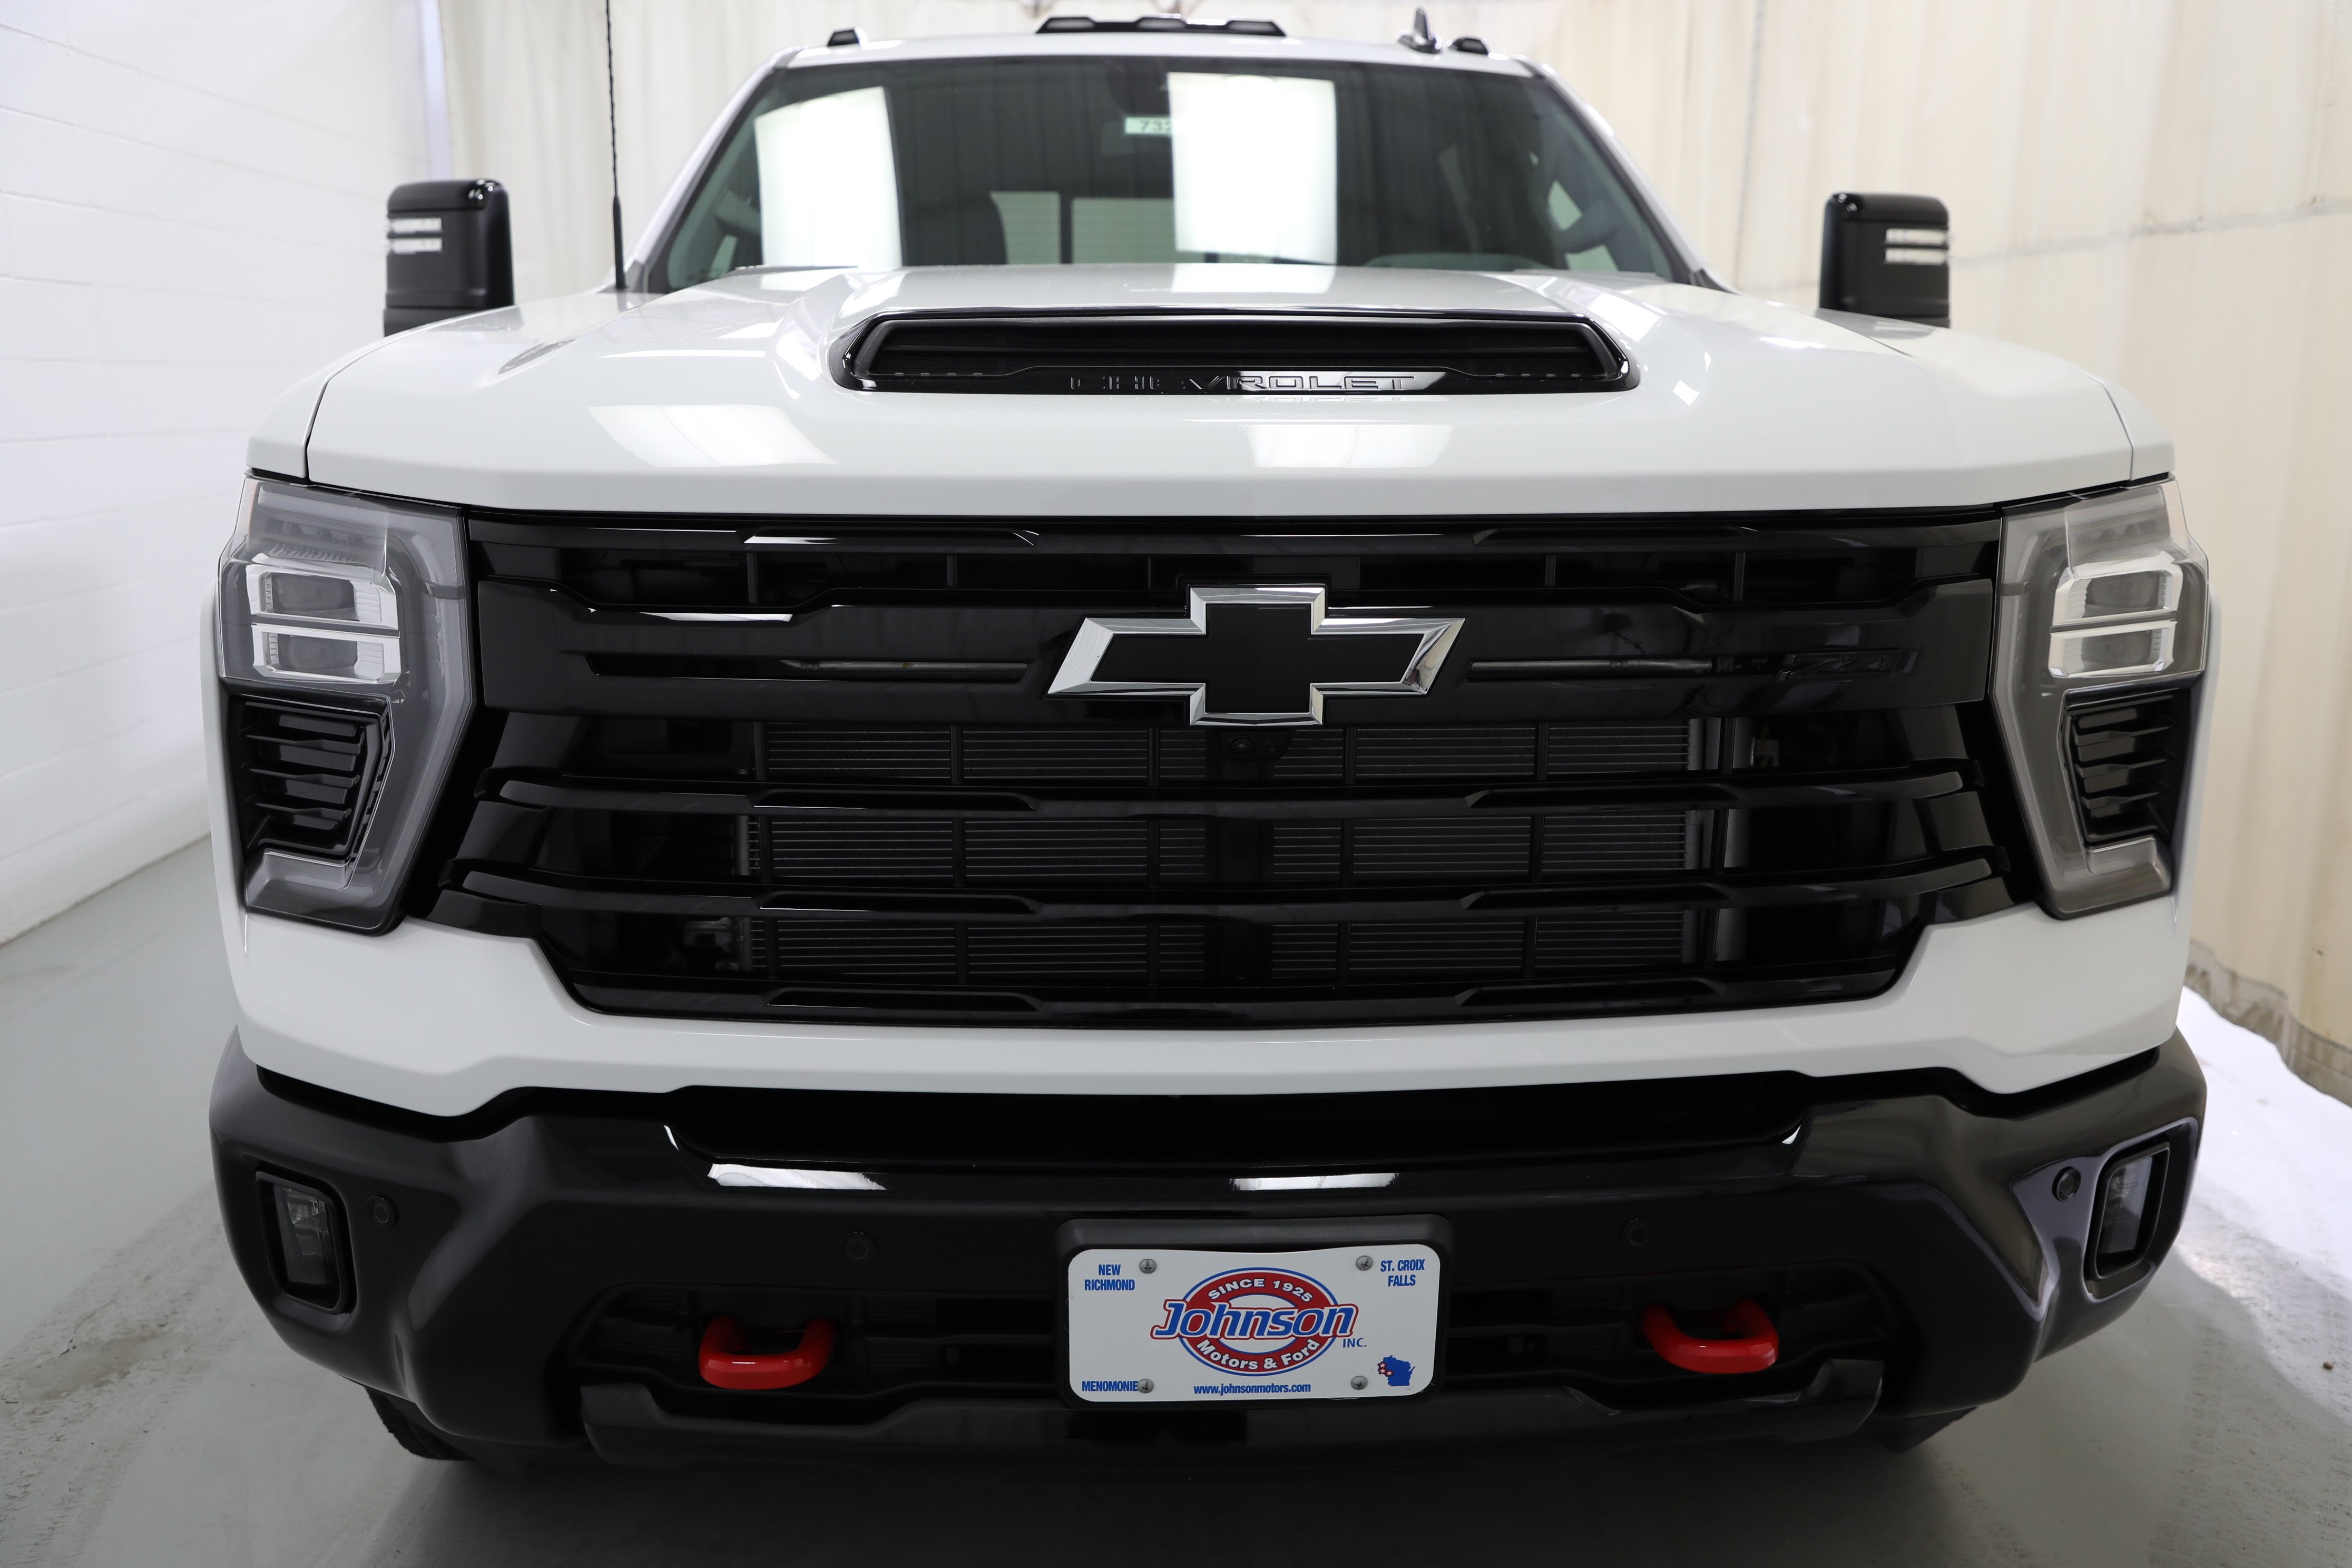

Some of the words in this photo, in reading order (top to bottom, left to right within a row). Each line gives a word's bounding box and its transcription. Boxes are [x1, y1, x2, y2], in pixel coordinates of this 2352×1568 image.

[1098, 1264, 1121, 1276] NEW
[1380, 1260, 1395, 1272] ST.
[1397, 1259, 1426, 1271] CROIX
[1084, 1279, 1135, 1291] RICHMOND
[1387, 1274, 1416, 1287] FALLS
[1208, 1278, 1265, 1300] SINCE
[1272, 1280, 1314, 1302] 1925
[1153, 1301, 1358, 1338] Johnson
[1342, 1337, 1367, 1348] INC.
[1196, 1339, 1259, 1370] Motors
[1263, 1357, 1278, 1369] &
[1280, 1338, 1320, 1366] Ford
[1082, 1380, 1139, 1391] MENOMONIE
[1193, 1383, 1311, 1396] www.johnsonmotors.com
